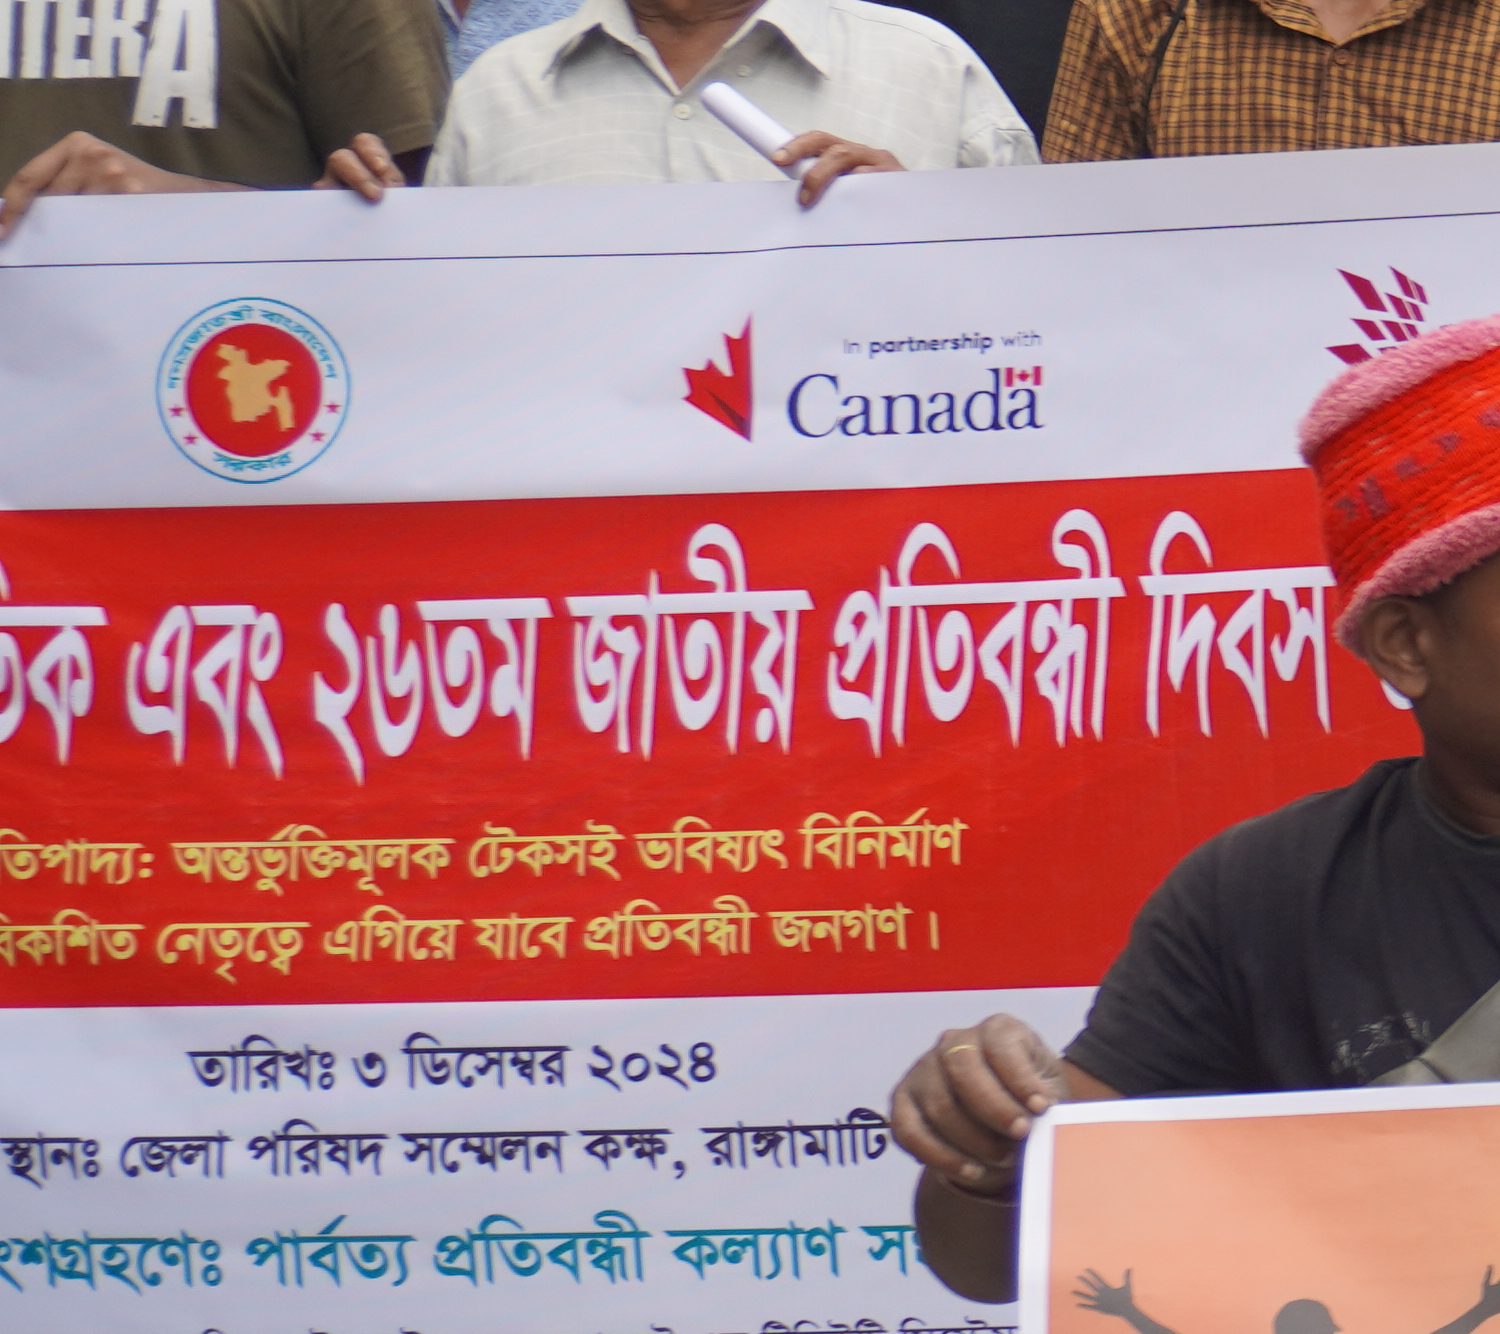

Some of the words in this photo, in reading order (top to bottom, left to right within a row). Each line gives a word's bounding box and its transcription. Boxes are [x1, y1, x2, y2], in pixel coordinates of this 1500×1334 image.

[843, 338, 862, 355] In
[868, 331, 994, 361] partnership
[1000, 330, 1042, 348] with
[787, 367, 1045, 439] Canada
[125, 604, 284, 781] এবং
[314, 598, 553, 785] ২৬তম
[569, 523, 813, 759] জাতীয়
[828, 509, 1127, 760] প্রতিবন্ধী
[1141, 510, 1336, 740] দিবস
[468, 819, 626, 881] টেকসই
[634, 816, 789, 874] ভবিষ্যৎ
[798, 807, 969, 869] বিনির্মাণ
[157, 920, 311, 985] নেতৃত্বে
[323, 904, 464, 962] এগিয়ে
[472, 913, 575, 961] যাবে
[583, 894, 760, 959] প্রতিবন্ধী
[352, 1051, 387, 1087] ৩
[400, 1031, 570, 1089] ডিসেম্বর
[587, 1041, 717, 1092] ২০২৪
[120, 1131, 232, 1178] জেলা
[247, 1118, 389, 1177] পরিষদ
[399, 1130, 569, 1174] সম্মেলন
[579, 1128, 687, 1179] কক্ষ,
[245, 1215, 416, 1288] পার্বত্য
[433, 1210, 652, 1286] প্রতিবন্ধী
[664, 1219, 846, 1281] কল্যাণ
